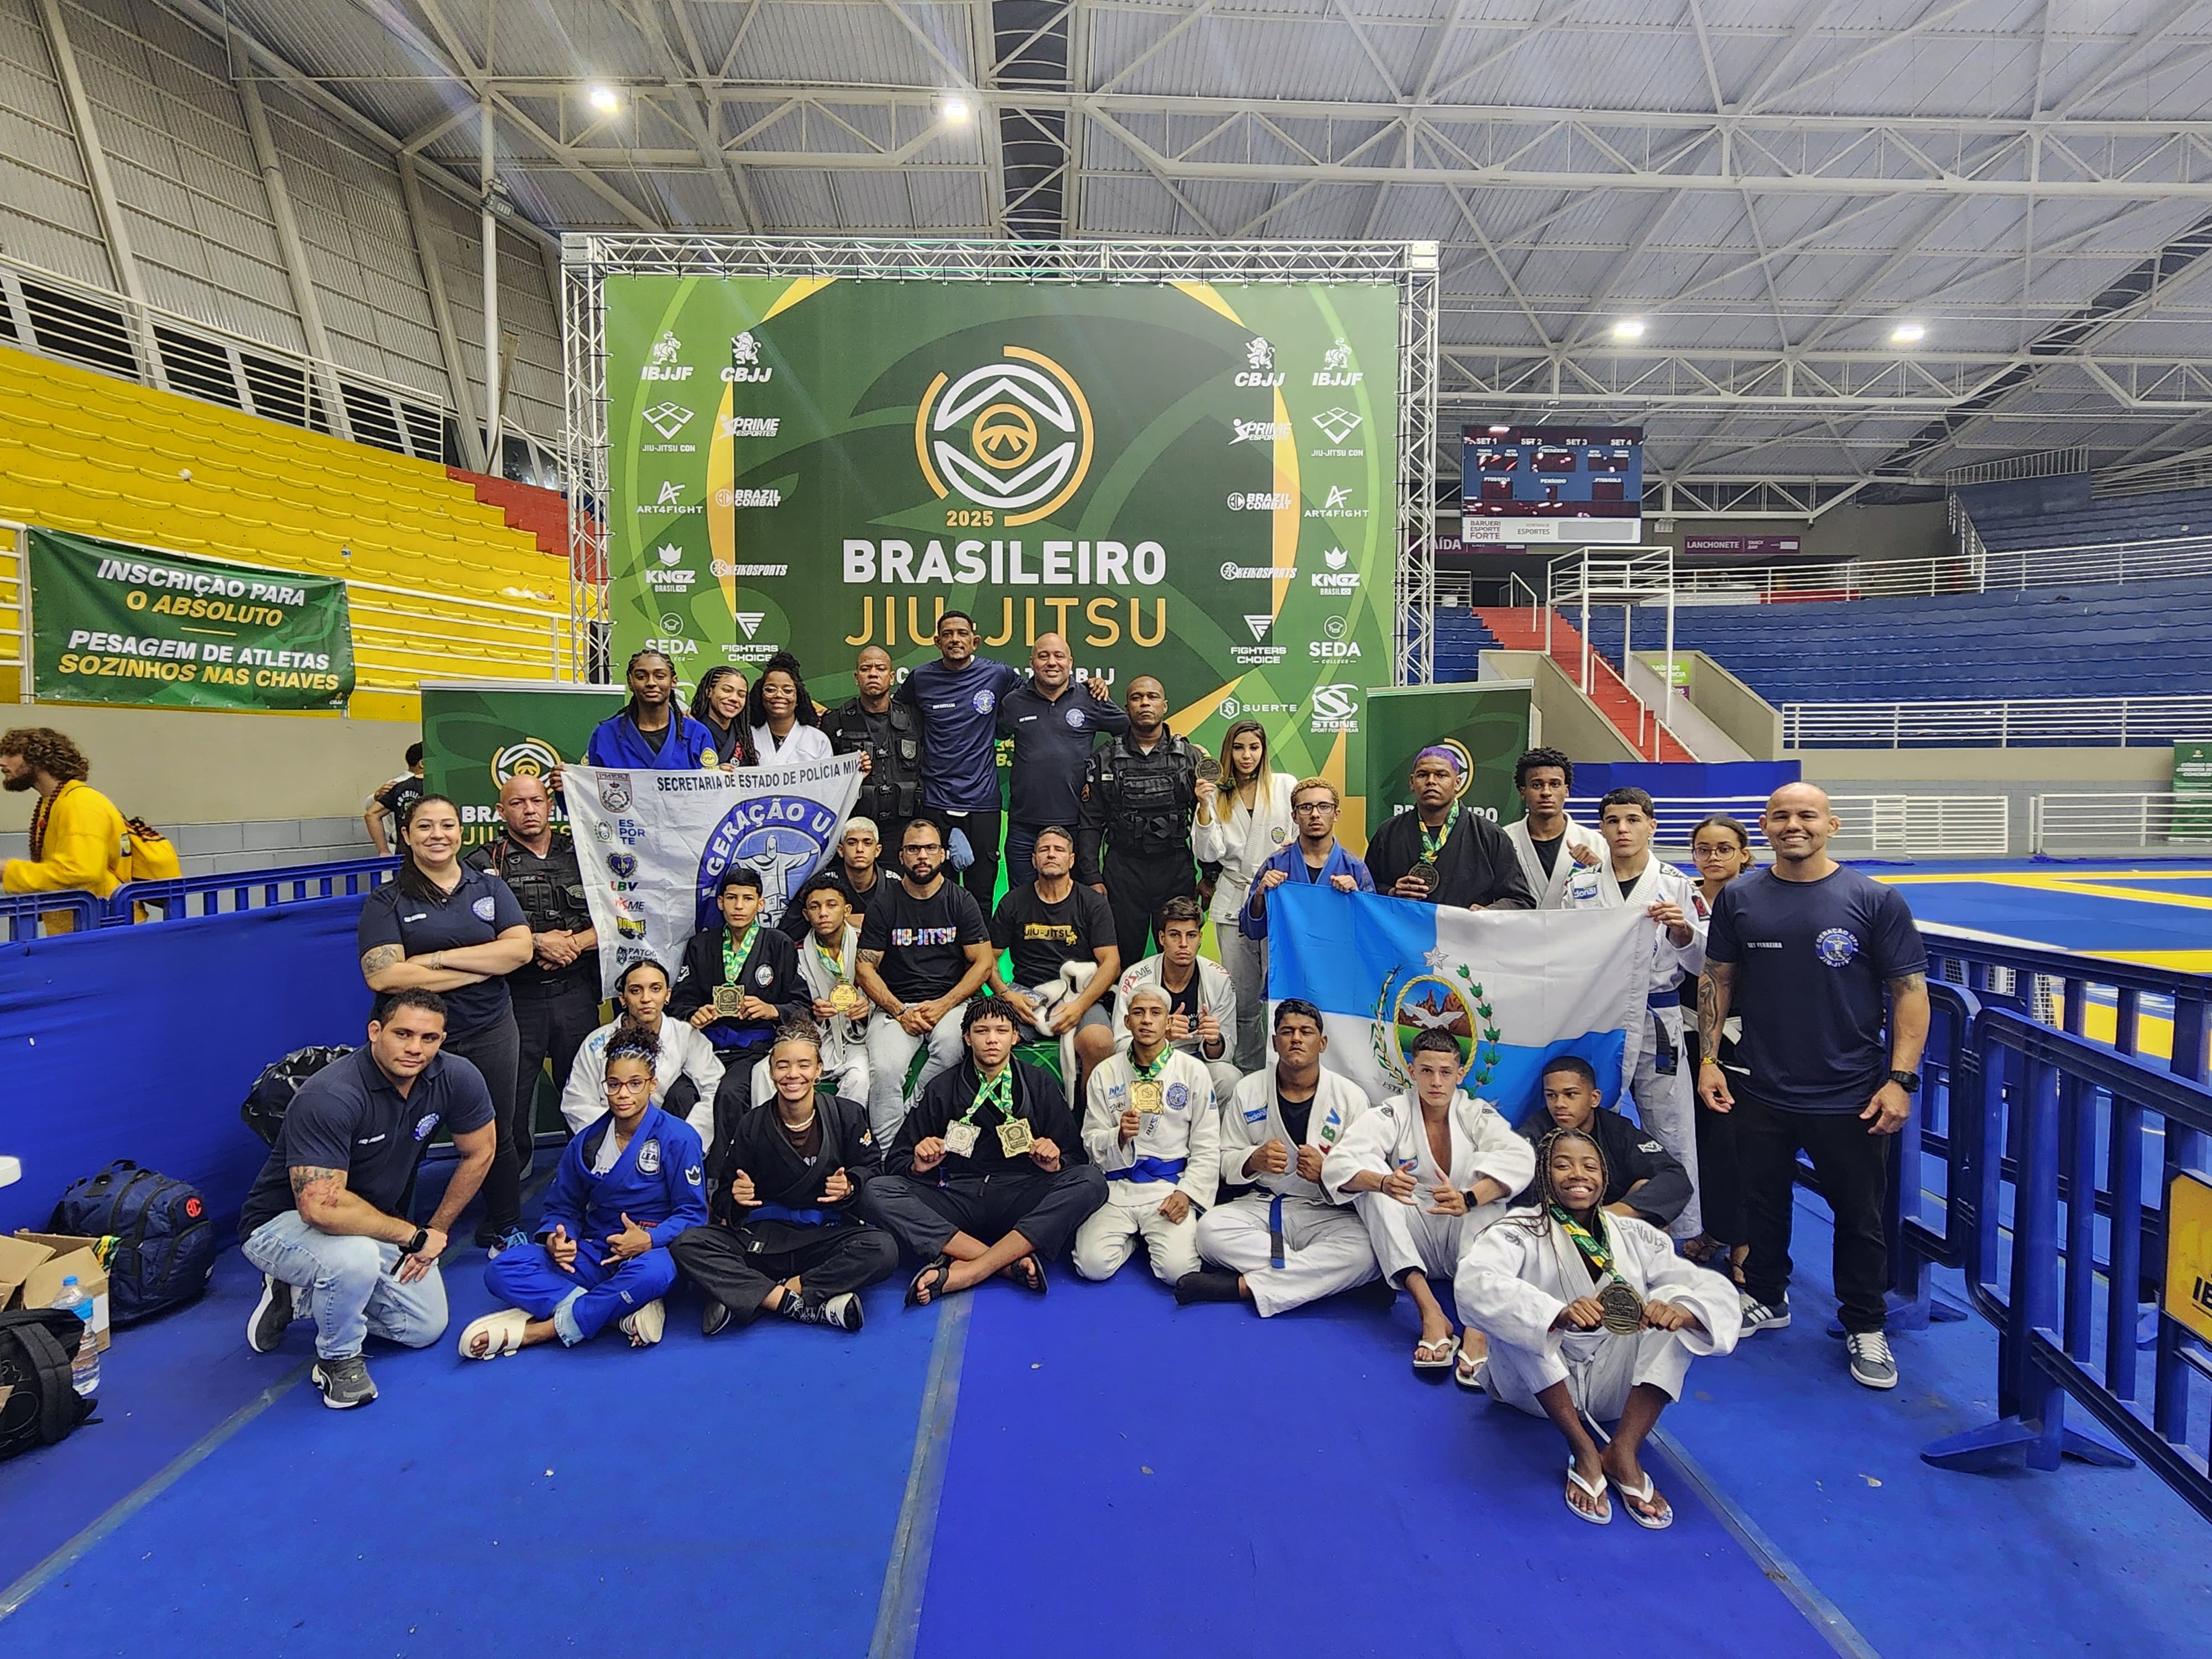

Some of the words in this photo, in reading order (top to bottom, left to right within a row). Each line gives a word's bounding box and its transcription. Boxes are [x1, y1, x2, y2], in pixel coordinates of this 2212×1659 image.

[641, 367, 693, 380] IBJJF
[720, 367, 773, 382] CBJJ
[1234, 372, 1286, 387] CBJJ
[1312, 372, 1363, 386] IBJJF
[733, 418, 780, 431] PRIME
[1247, 422, 1292, 435] PRIME
[734, 489, 781, 500] BRAZIL
[1246, 493, 1292, 504] BRAZIL
[734, 498, 780, 507] COMBAT
[1246, 501, 1291, 510] COMBAT
[946, 510, 994, 527] 2025
[843, 539, 1166, 585] BRASILEIRO
[725, 565, 788, 576] KEIKOSPORTS
[1235, 567, 1297, 579] KEIKOSPORTS
[97, 560, 246, 598] INSCRIÇÃO
[249, 583, 305, 607] PARA
[126, 591, 147, 611] O
[152, 595, 283, 627] ABSOLUTO
[844, 596, 1166, 648] JIUJITSU
[67, 630, 197, 661] PESAGEM
[202, 644, 233, 663] DE
[237, 648, 329, 670] ATLETAS
[645, 639, 698, 654] SEDA
[1230, 646, 1287, 655] FIGHTERS
[1309, 641, 1361, 657] SEDA
[58, 653, 196, 682] SOZINHOS
[201, 667, 251, 685] NAS
[255, 670, 339, 691] CHAVES
[657, 774, 722, 792] SECRETARIA
[725, 775, 736, 787] DE
[739, 774, 780, 789] ESTADO
[783, 771, 796, 786] DE
[800, 761, 841, 784] POLÍCIA
[619, 828, 645, 837] POR
[706, 798, 805, 877] GERAÇÃO
[611, 881, 639, 891] LBV
[1024, 927, 1072, 938] JIU-JITSU
[1382, 1082, 1404, 1094] ESTA
